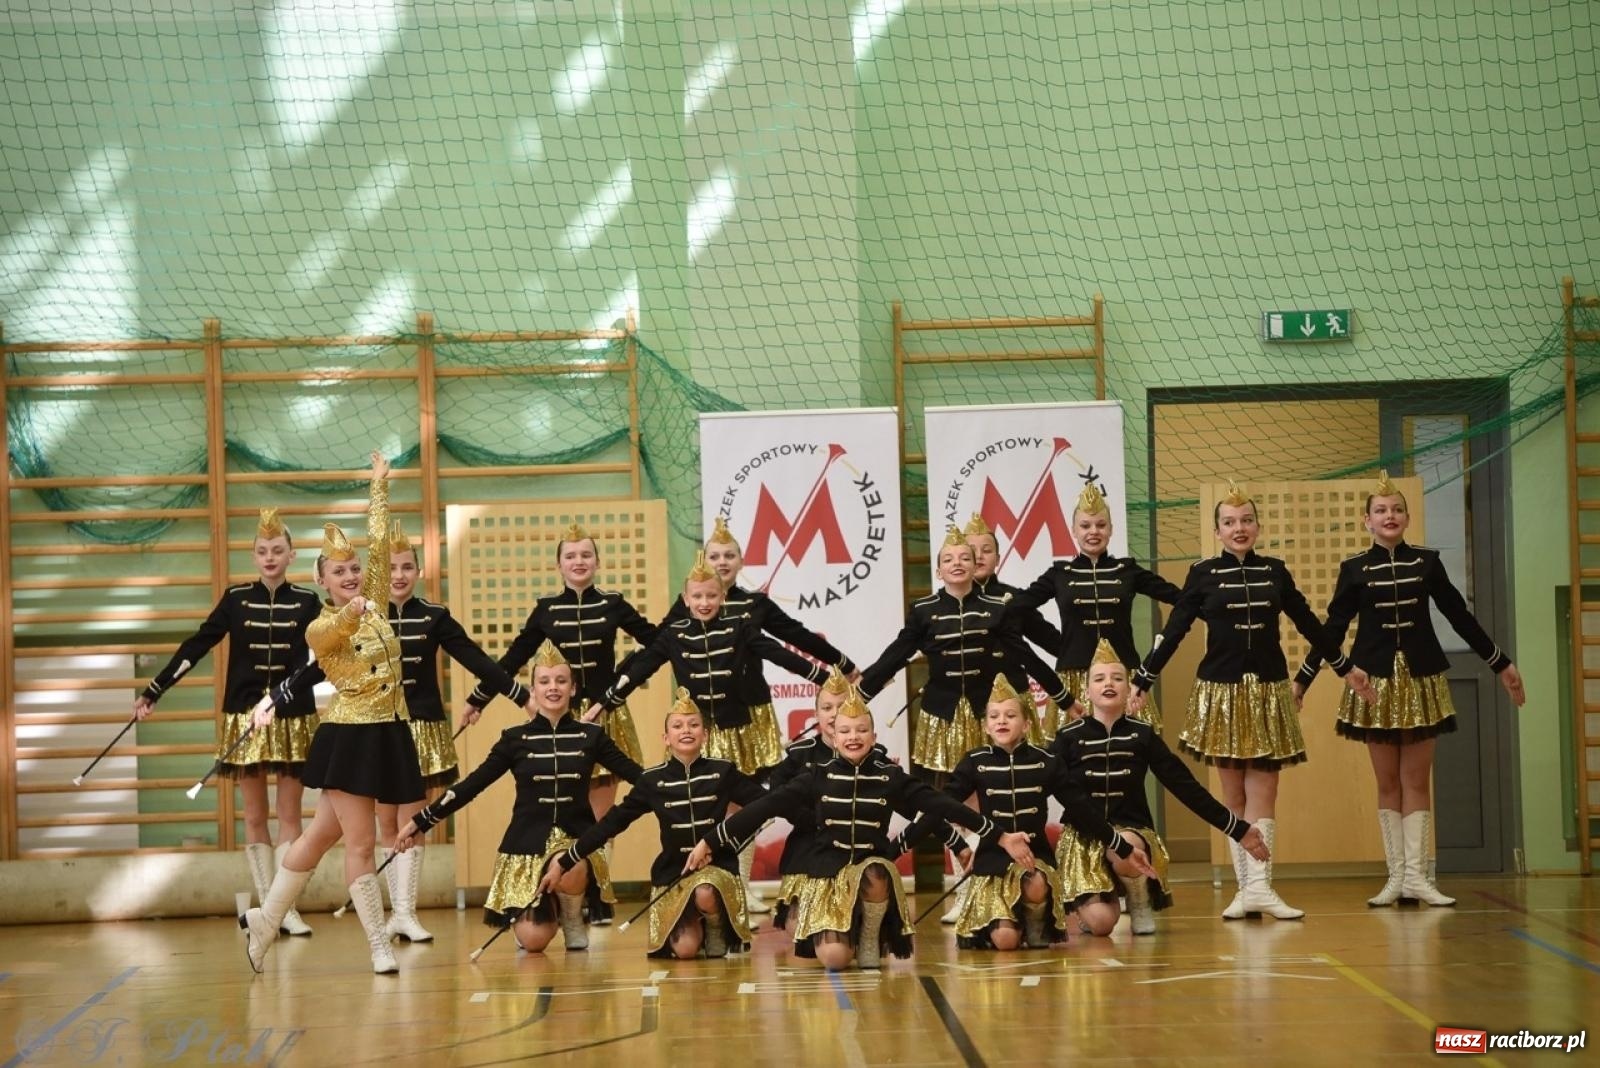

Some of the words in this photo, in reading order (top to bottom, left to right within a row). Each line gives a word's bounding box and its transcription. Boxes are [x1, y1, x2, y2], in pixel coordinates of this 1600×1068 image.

[734, 443, 818, 484] SPORTOWY
[960, 437, 1044, 478] SPORTOWY
[798, 471, 886, 610] MAŻORETEK
[770, 684, 822, 699] SMAZO
